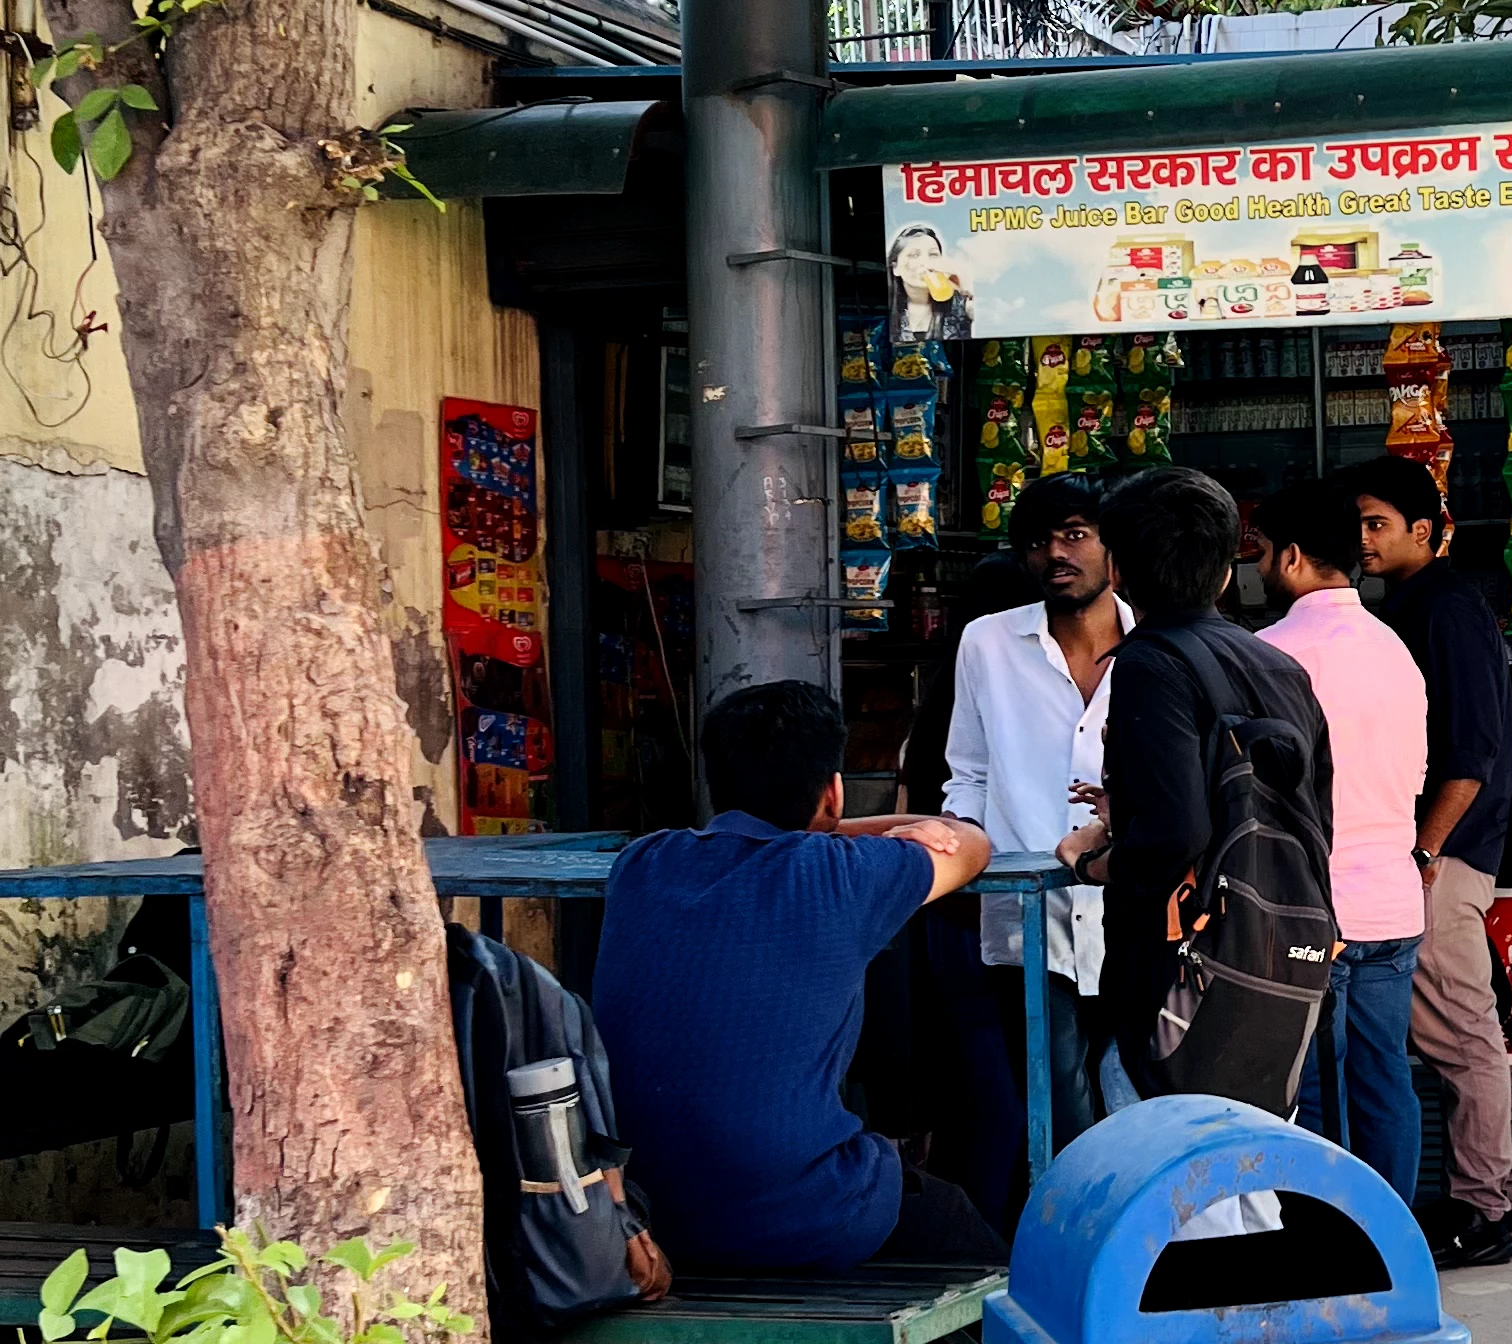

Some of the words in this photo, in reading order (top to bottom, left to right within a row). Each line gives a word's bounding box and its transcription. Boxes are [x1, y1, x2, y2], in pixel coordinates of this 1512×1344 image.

[901, 158, 1078, 203] हिमाचल
[1086, 150, 1241, 192] सरकार
[1250, 146, 1314, 183] का
[1326, 136, 1481, 179] उपक्रम
[969, 204, 1044, 232] HPMC
[1050, 203, 1118, 229] Juice
[1124, 201, 1168, 225] Bar
[1174, 197, 1240, 223] Good
[1247, 192, 1331, 219] Health
[1337, 187, 1411, 214] Great
[1416, 183, 1492, 210] Taste
[1287, 944, 1326, 964] safari
